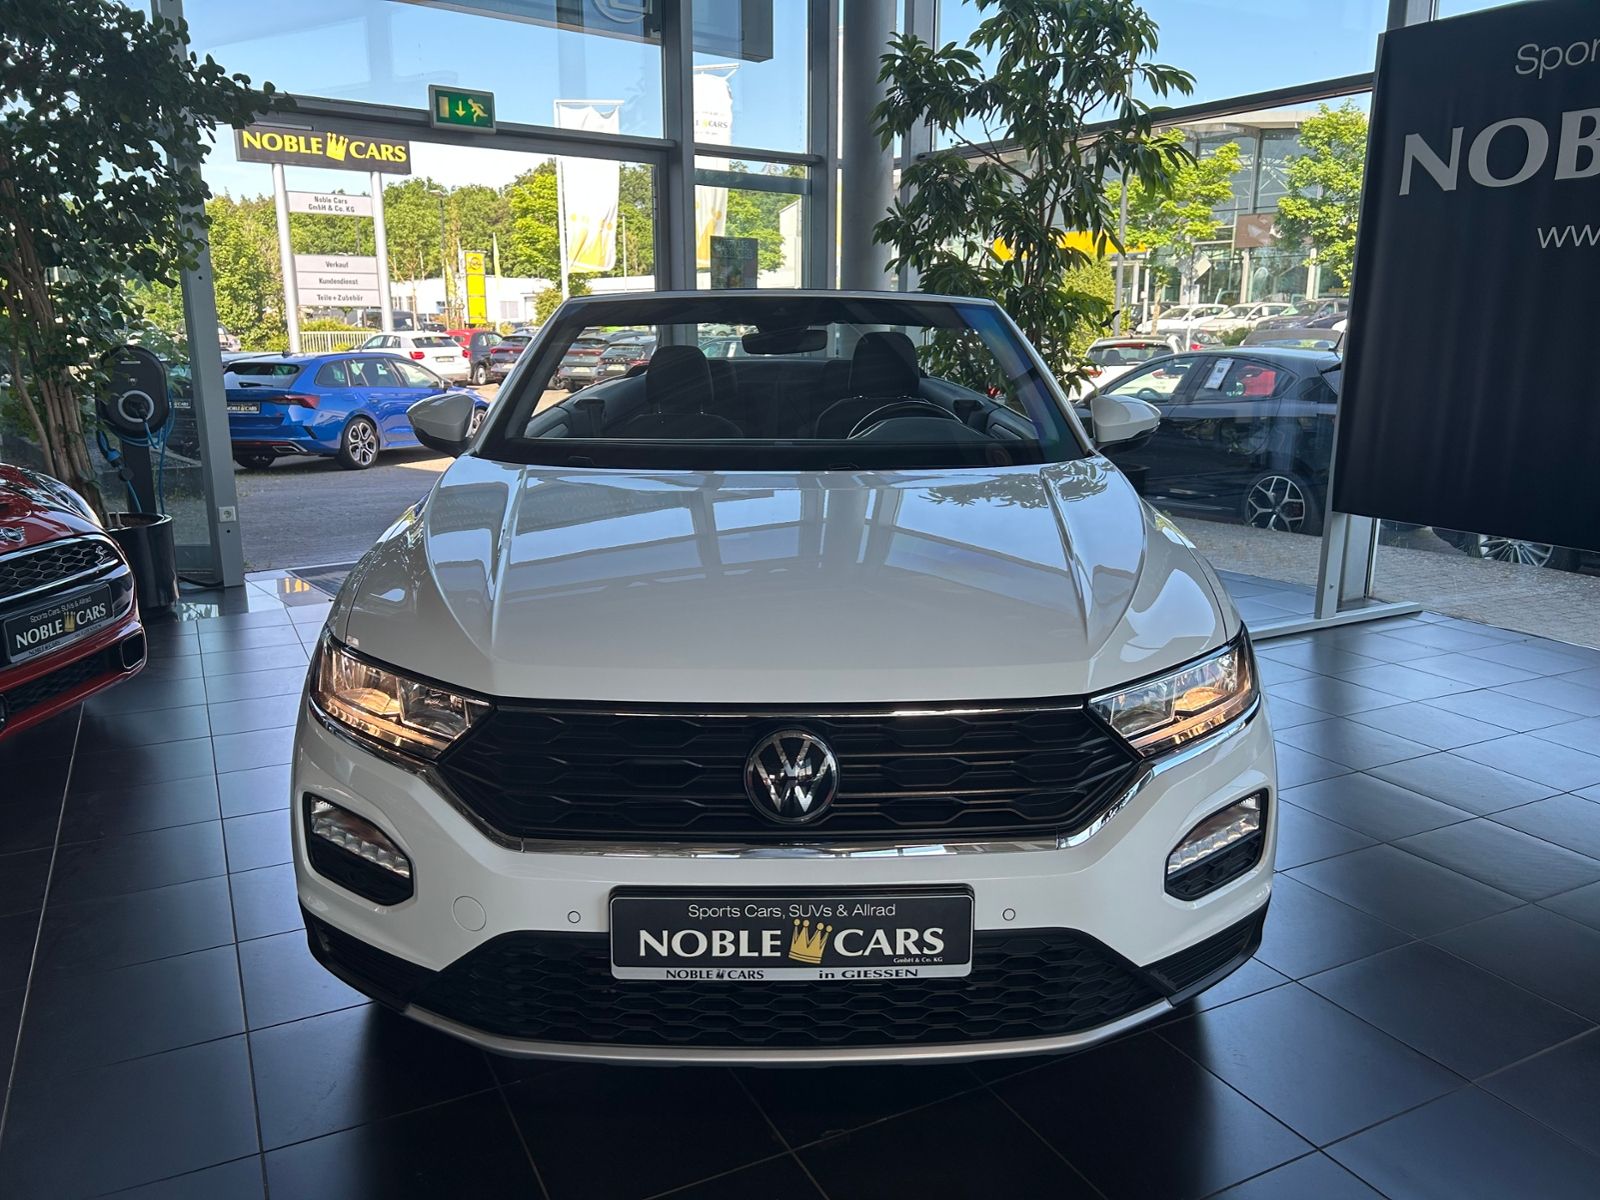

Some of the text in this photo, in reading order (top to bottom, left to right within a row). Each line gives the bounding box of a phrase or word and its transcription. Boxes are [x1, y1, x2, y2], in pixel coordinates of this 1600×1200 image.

[242, 130, 408, 163] NOBLE CARS
[1399, 107, 1600, 196] NOB
[15, 619, 64, 649] NOBLE
[76, 602, 107, 625] CARS
[688, 903, 896, 920] Sports Cars, SUVs & Allrad
[639, 926, 945, 958] NOBLE CARS
[665, 968, 919, 980] NOBLE CARS in GIESSEN
